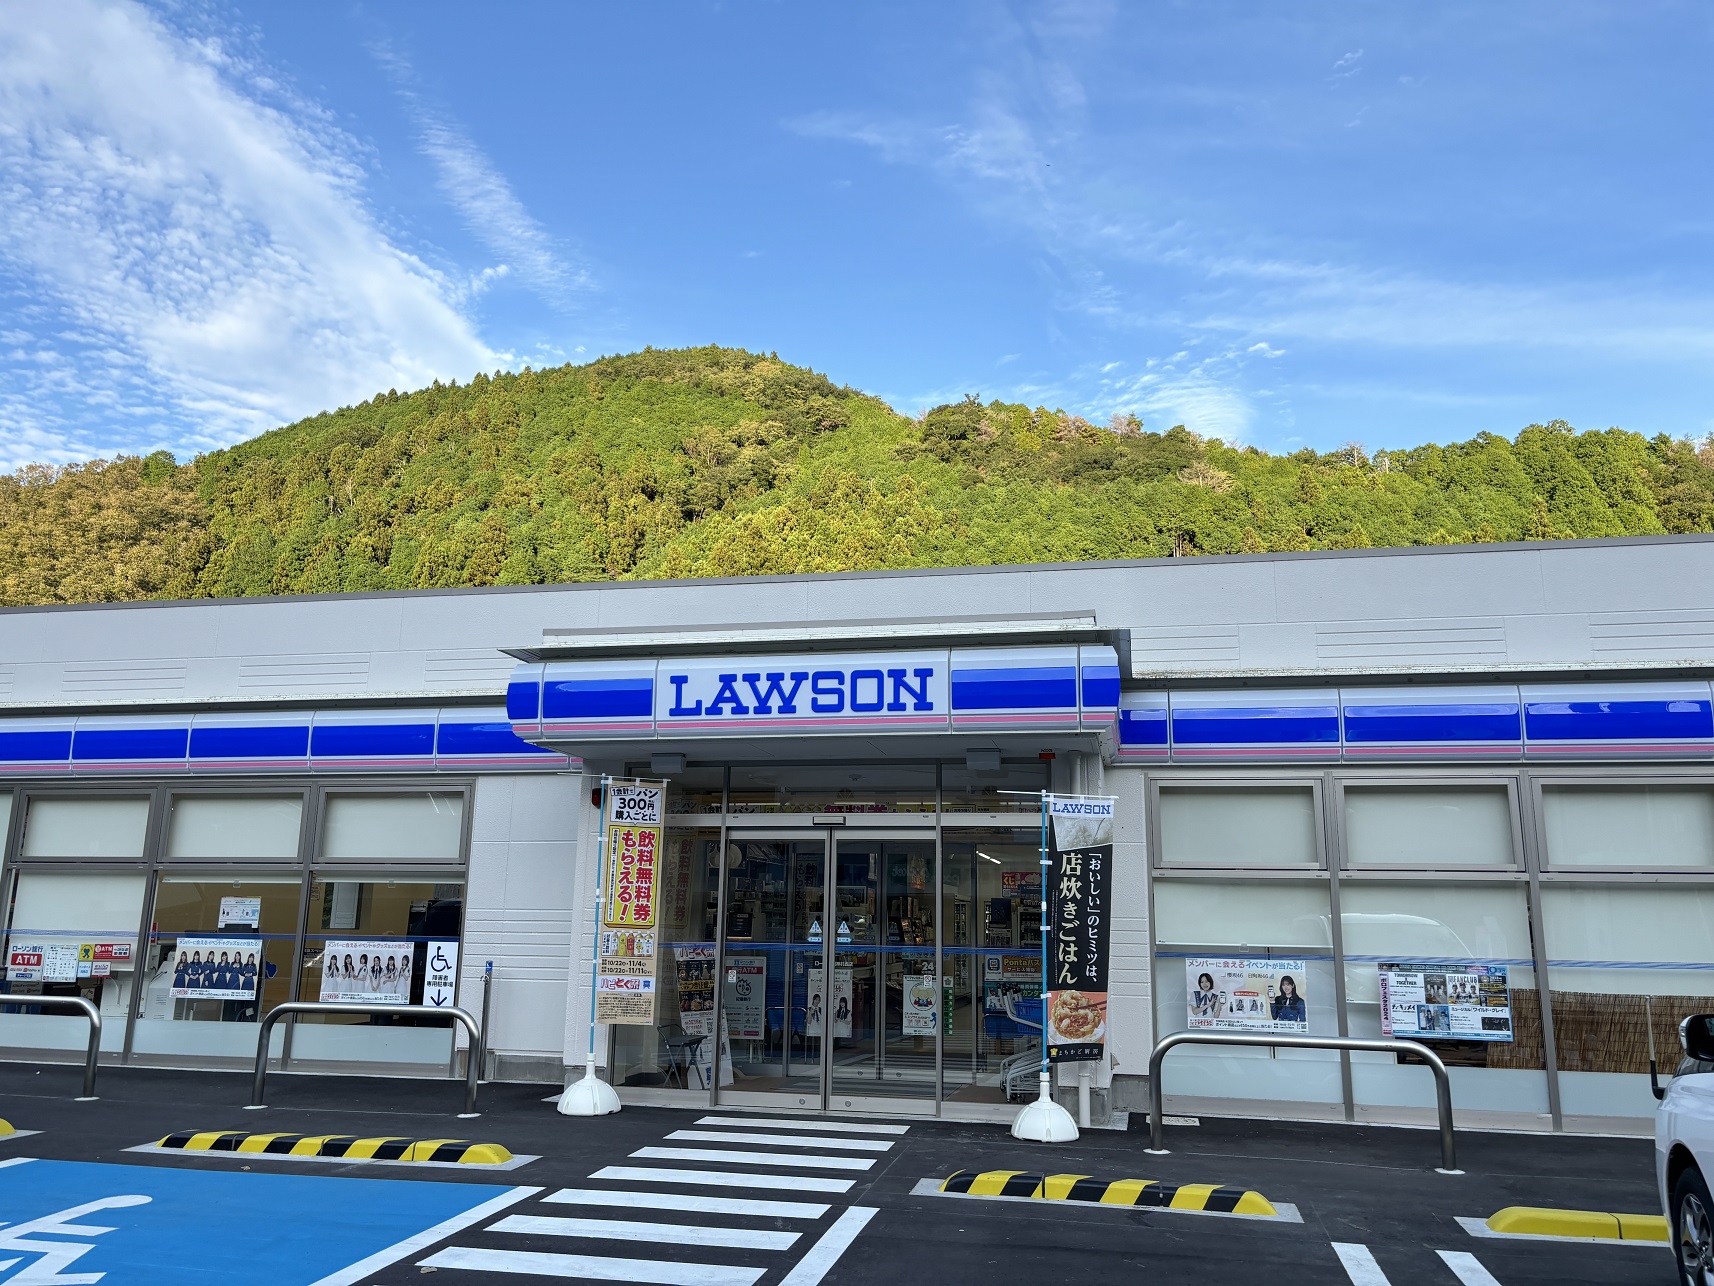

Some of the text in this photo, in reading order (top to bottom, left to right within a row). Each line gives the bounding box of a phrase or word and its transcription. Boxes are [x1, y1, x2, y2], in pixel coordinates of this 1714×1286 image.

[669, 667, 933, 717] LAWSON
[636, 788, 658, 799] パン
[618, 798, 655, 811] 300円
[1053, 802, 1111, 815] LAWSON
[615, 809, 657, 822] 購入ごとに
[633, 830, 656, 922] 飲料無料券
[1058, 851, 1083, 985] 店炊きごはん
[1086, 853, 1102, 982] 「おいしい」のヒミツは、
[12, 945, 44, 953] ローソン銀行
[15, 955, 38, 965] ATM
[922, 962, 935, 970] 24
[1188, 960, 1304, 971] メンバーに会えるイベントが当たる!
[426, 980, 454, 988] 専用駐車場
